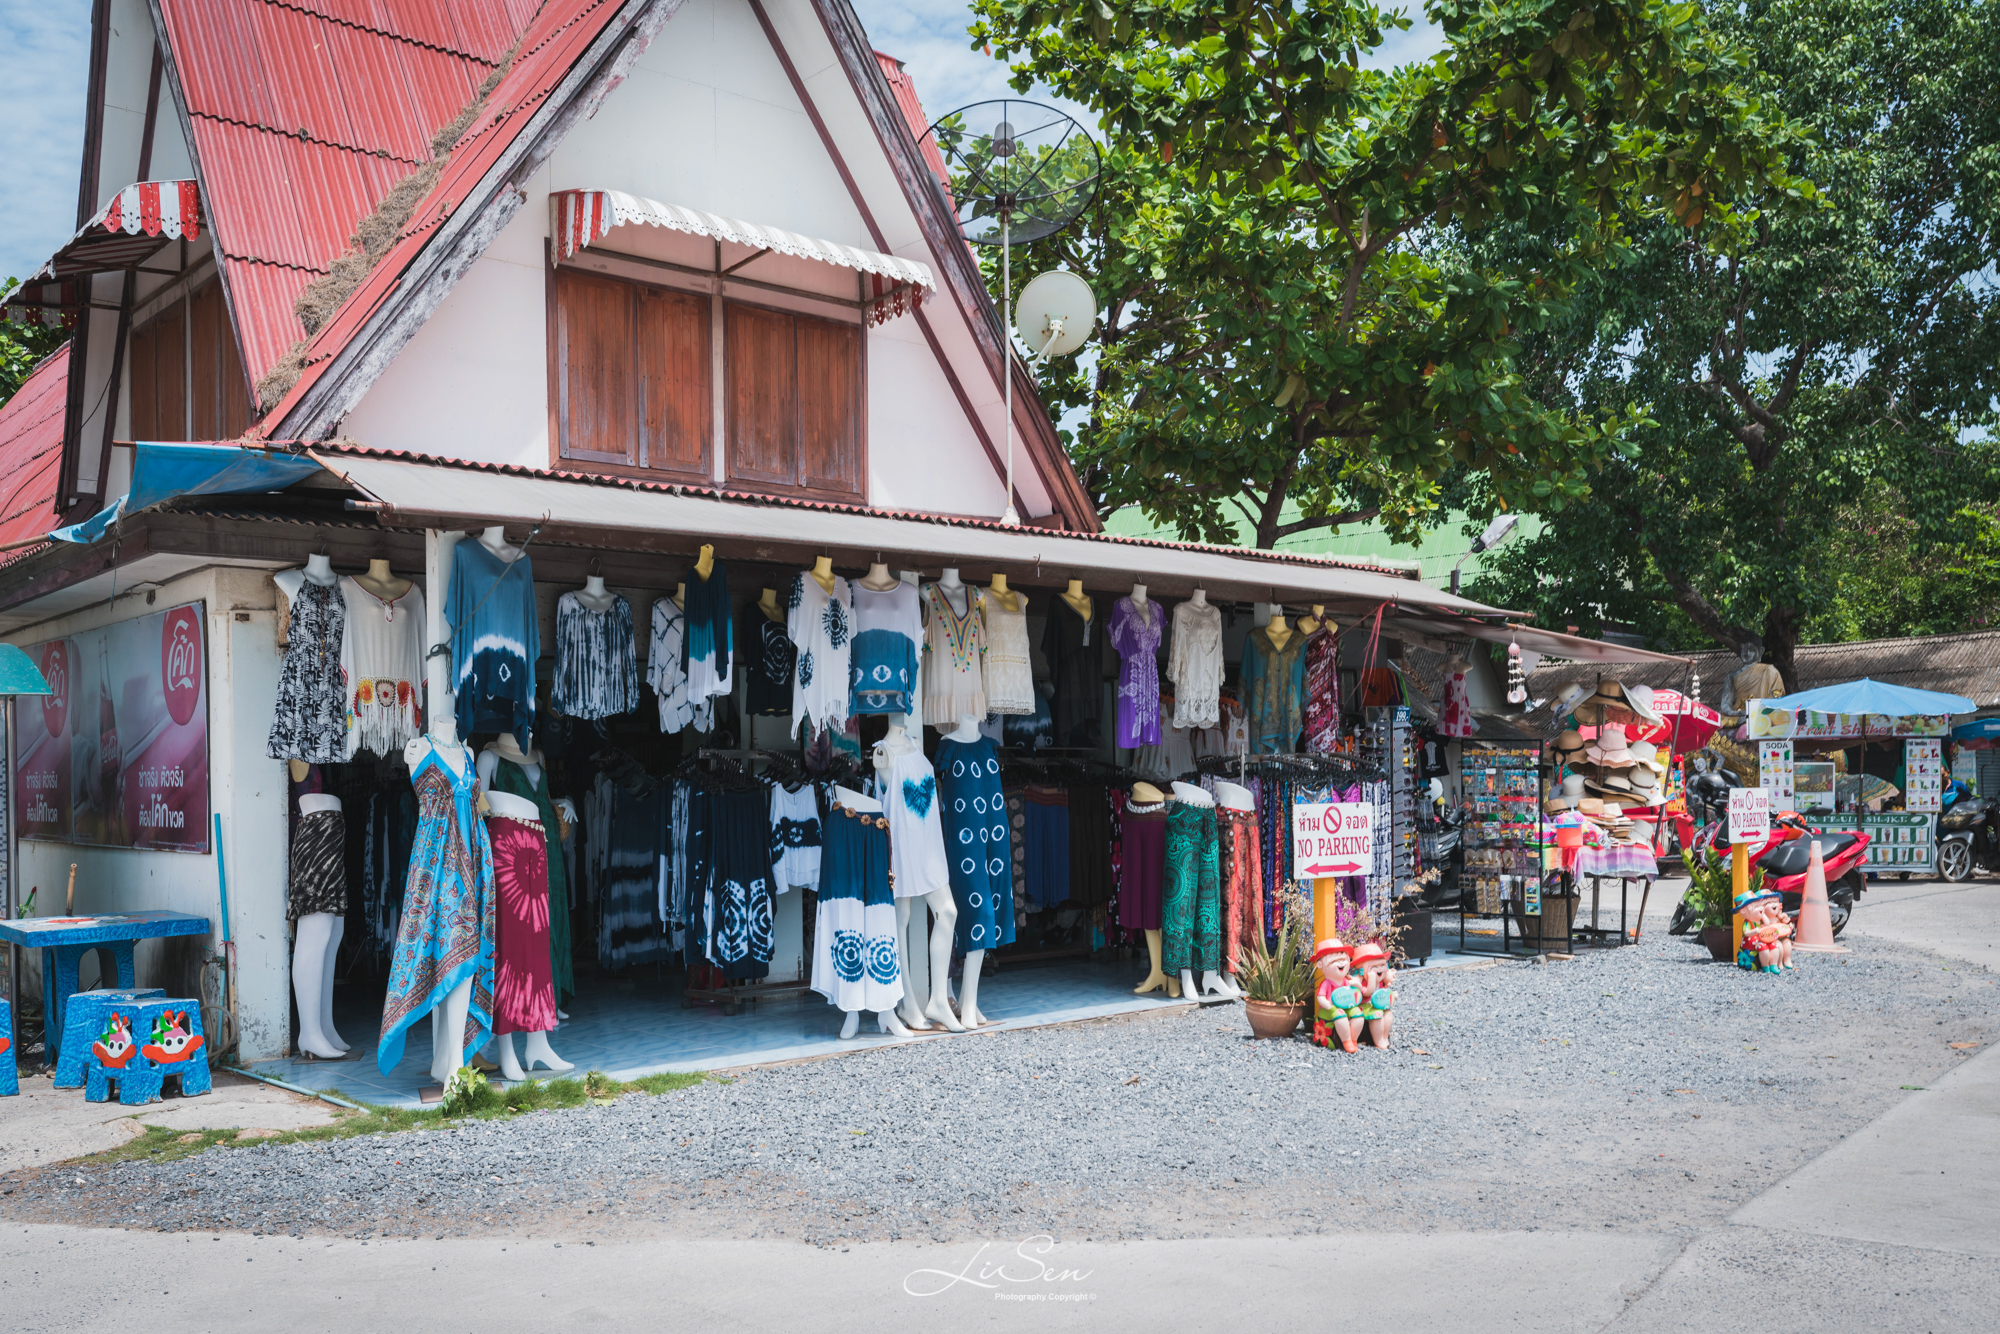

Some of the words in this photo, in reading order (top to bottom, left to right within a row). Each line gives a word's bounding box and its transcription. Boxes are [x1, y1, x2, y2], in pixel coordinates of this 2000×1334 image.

[1796, 723, 1836, 736] Fruit
[1732, 794, 1745, 809] ห้าม
[1755, 797, 1767, 808] จอด
[1298, 811, 1320, 832] ห้าม
[1345, 815, 1368, 829] จอด
[1731, 813, 1741, 828] NO
[1743, 812, 1767, 827] PARKING
[1297, 838, 1313, 858] NO
[1318, 836, 1370, 856] PARKING
